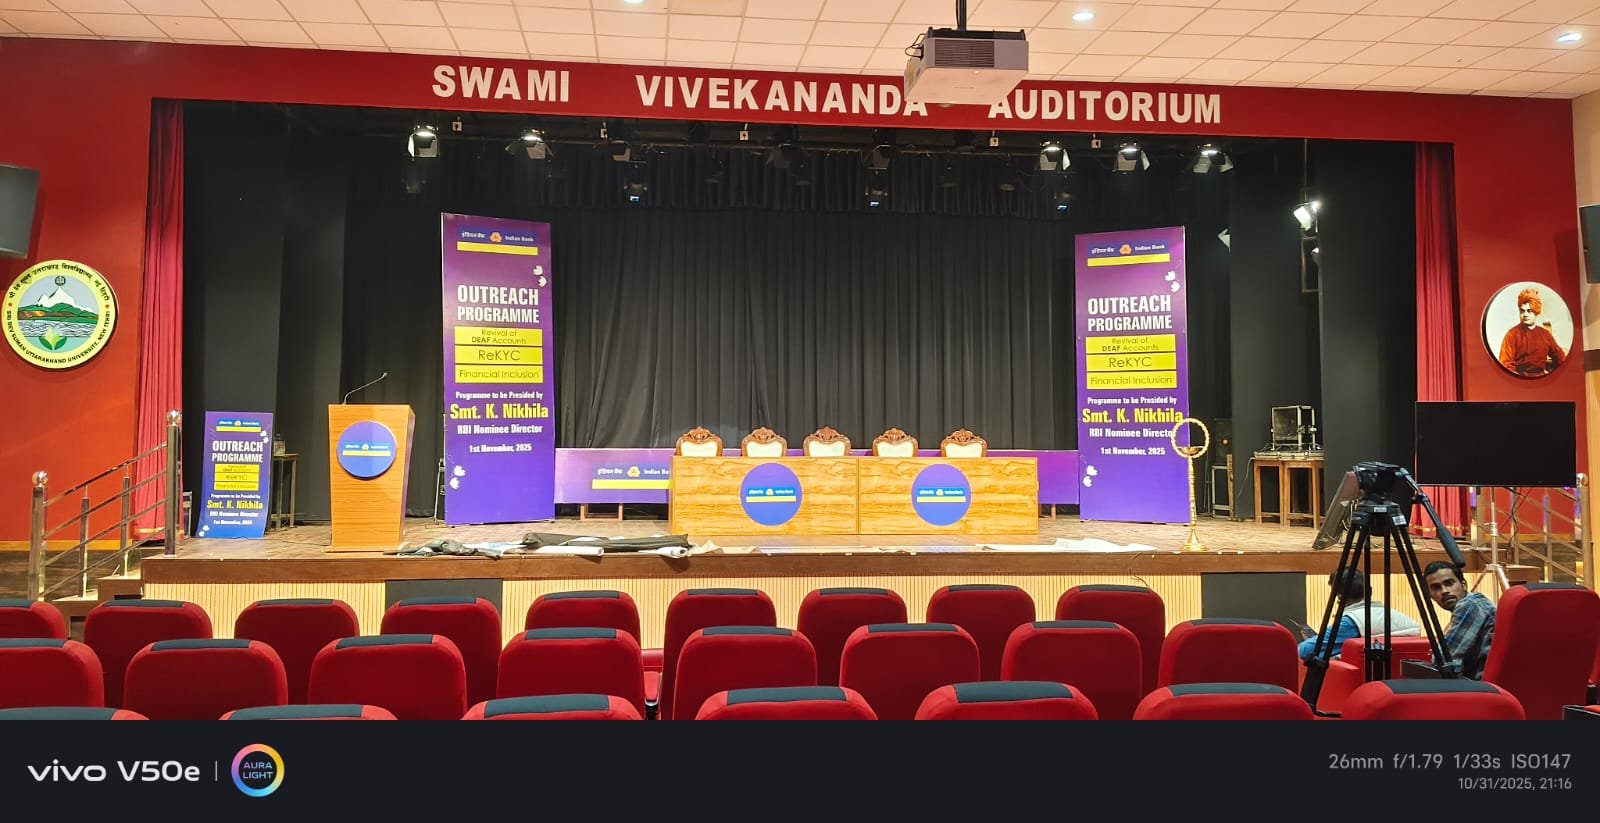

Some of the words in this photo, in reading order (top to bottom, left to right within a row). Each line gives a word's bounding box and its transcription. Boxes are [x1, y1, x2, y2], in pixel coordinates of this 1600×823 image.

[432, 64, 570, 103] SWAMI
[635, 74, 928, 117] VIVEKANANDA
[988, 89, 1221, 124] AUDITORIUM
[457, 284, 539, 306] OUTREACH
[1087, 294, 1172, 315] OUTREACH
[458, 306, 540, 324] PROGRAMME
[1088, 314, 1172, 332] PROGRAMME
[1122, 344, 1158, 352] Accounts
[478, 350, 520, 361] ReKYC
[1108, 356, 1152, 368] ReKYC
[459, 370, 500, 379] Financial
[502, 370, 539, 379] Inclusion
[1090, 376, 1131, 384] Financial
[1132, 375, 1172, 384] Inclusion
[456, 391, 490, 400] Programme
[536, 392, 544, 400] by
[1087, 396, 1122, 405] Programme
[1169, 396, 1177, 404] by
[450, 404, 481, 420] Smt.
[486, 404, 499, 419] K.
[502, 403, 549, 418] Nikhila
[1082, 408, 1113, 424] Smt.
[1116, 408, 1130, 423] K.
[1134, 408, 1184, 424] Nikhila
[457, 424, 472, 435] RBI
[474, 424, 509, 434] Nominee
[511, 424, 543, 434] Director
[1089, 428, 1102, 438] RBI
[1105, 428, 1140, 438] Nominee
[1143, 428, 1173, 438] Directo
[212, 440, 264, 452] OUTREACH
[470, 444, 480, 453] 1st
[516, 444, 532, 452] 2025
[1101, 447, 1112, 455] 1st
[1148, 448, 1166, 456] 2025
[212, 452, 264, 463] PROGRAMME
